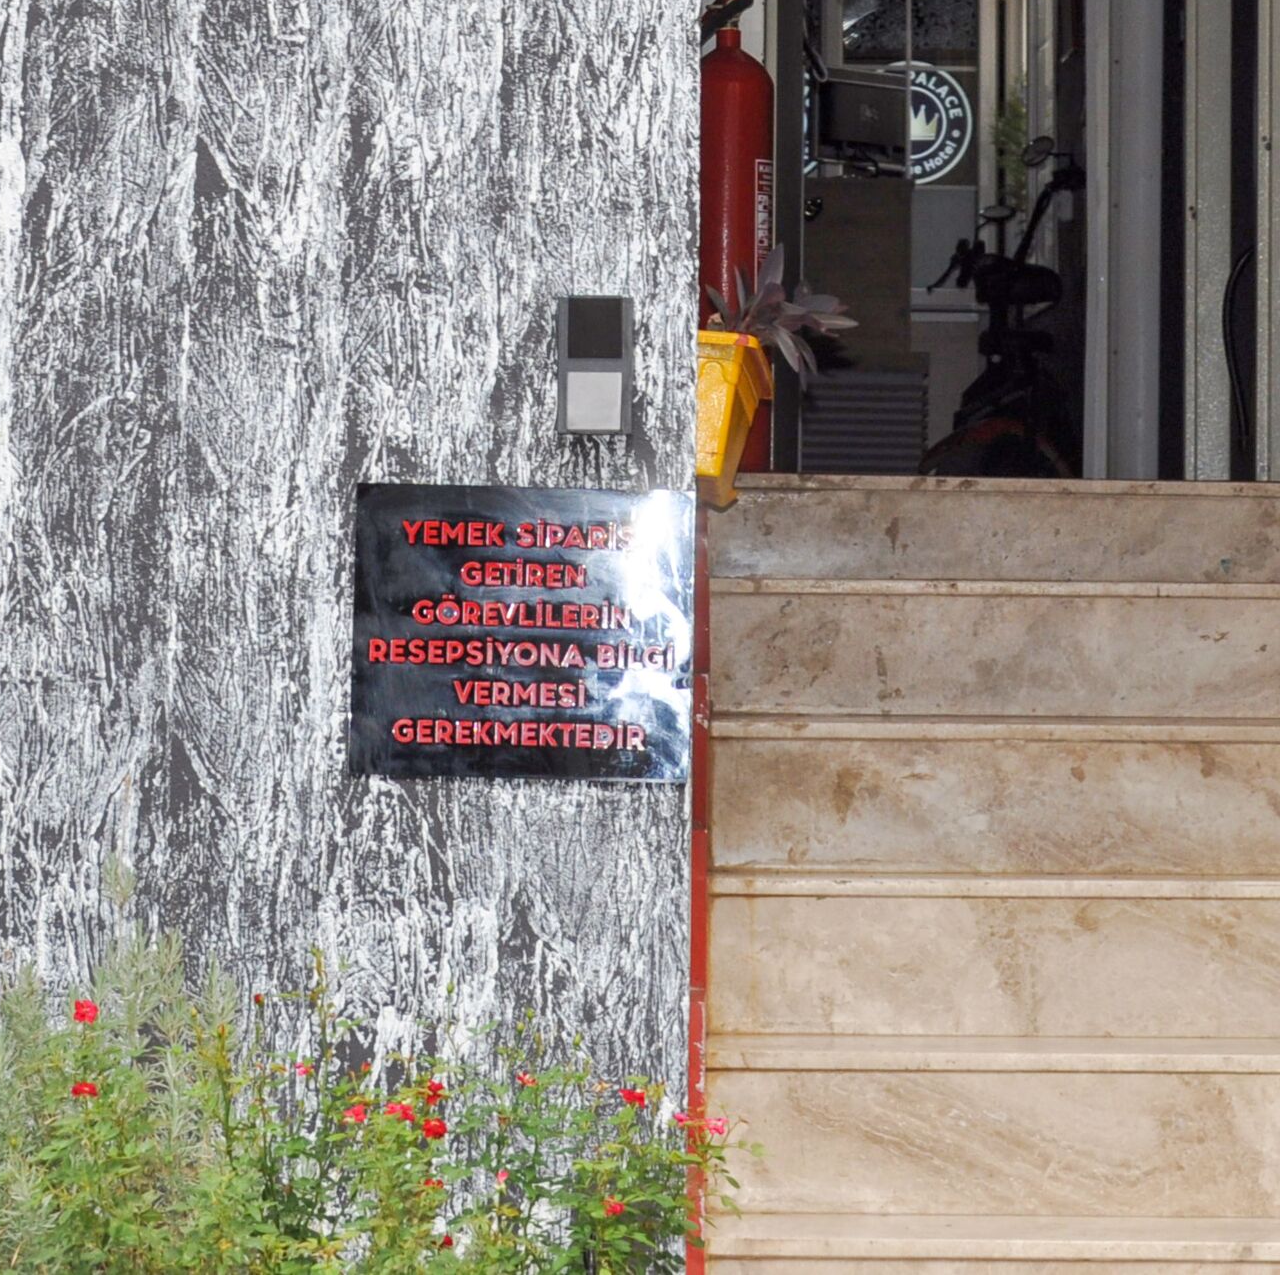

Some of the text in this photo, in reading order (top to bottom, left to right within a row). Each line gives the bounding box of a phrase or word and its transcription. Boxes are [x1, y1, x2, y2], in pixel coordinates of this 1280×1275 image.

[923, 140, 958, 173] Hotel
[402, 520, 505, 548] YEMEK
[460, 558, 587, 589] GETİREN
[412, 594, 632, 630] GÖREVLİLERİN
[368, 636, 586, 669] RESEPSİYONA
[453, 679, 587, 708] VERMESİ
[391, 718, 647, 751] GEREKMEKTEDİR
